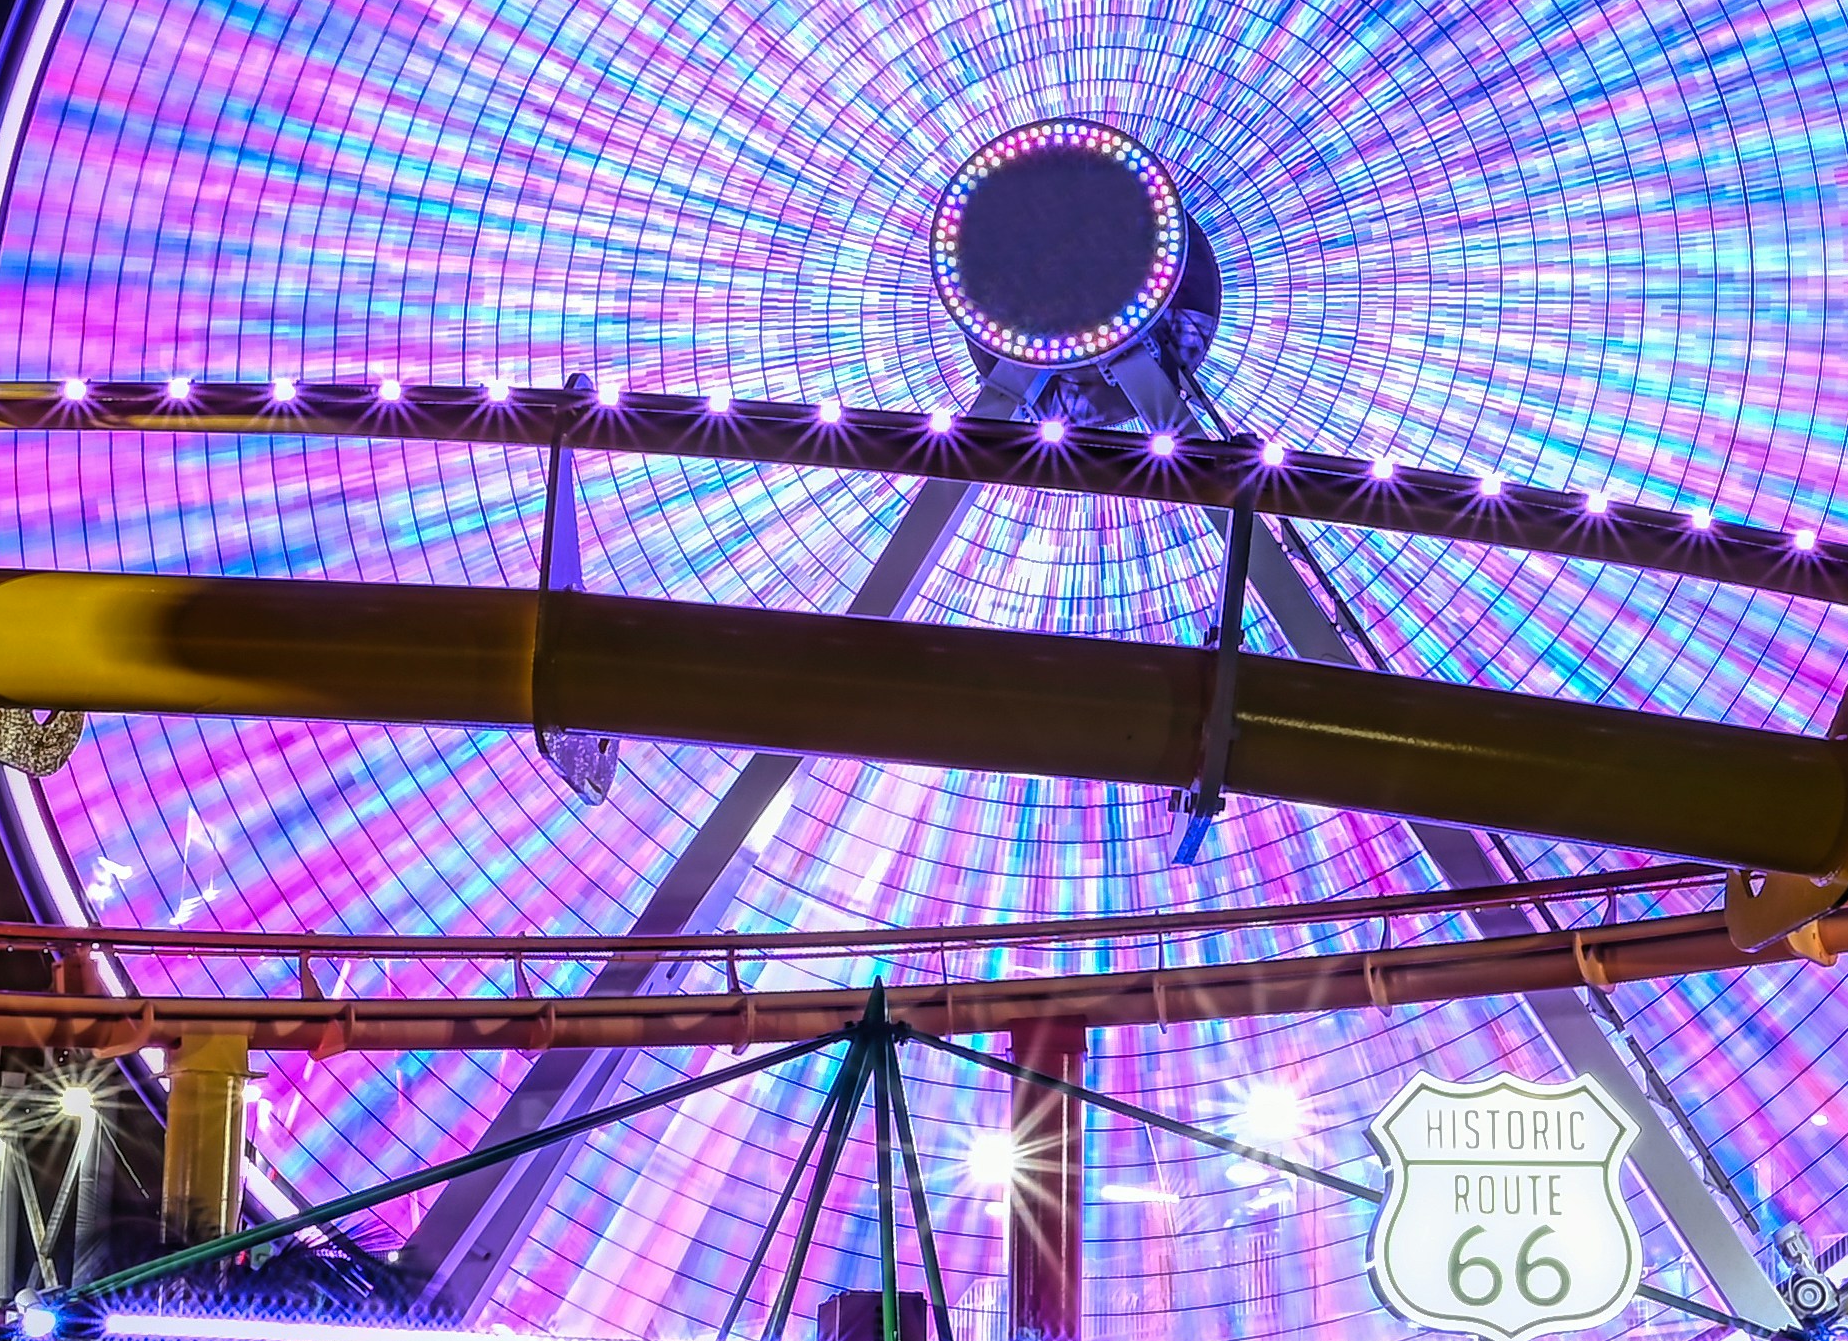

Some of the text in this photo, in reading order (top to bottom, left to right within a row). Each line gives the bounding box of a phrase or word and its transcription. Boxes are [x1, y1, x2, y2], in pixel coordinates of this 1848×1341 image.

[1425, 1109, 1586, 1152] HISTORIC
[1454, 1173, 1563, 1217] ROUTE
[1447, 1223, 1572, 1308] 66
